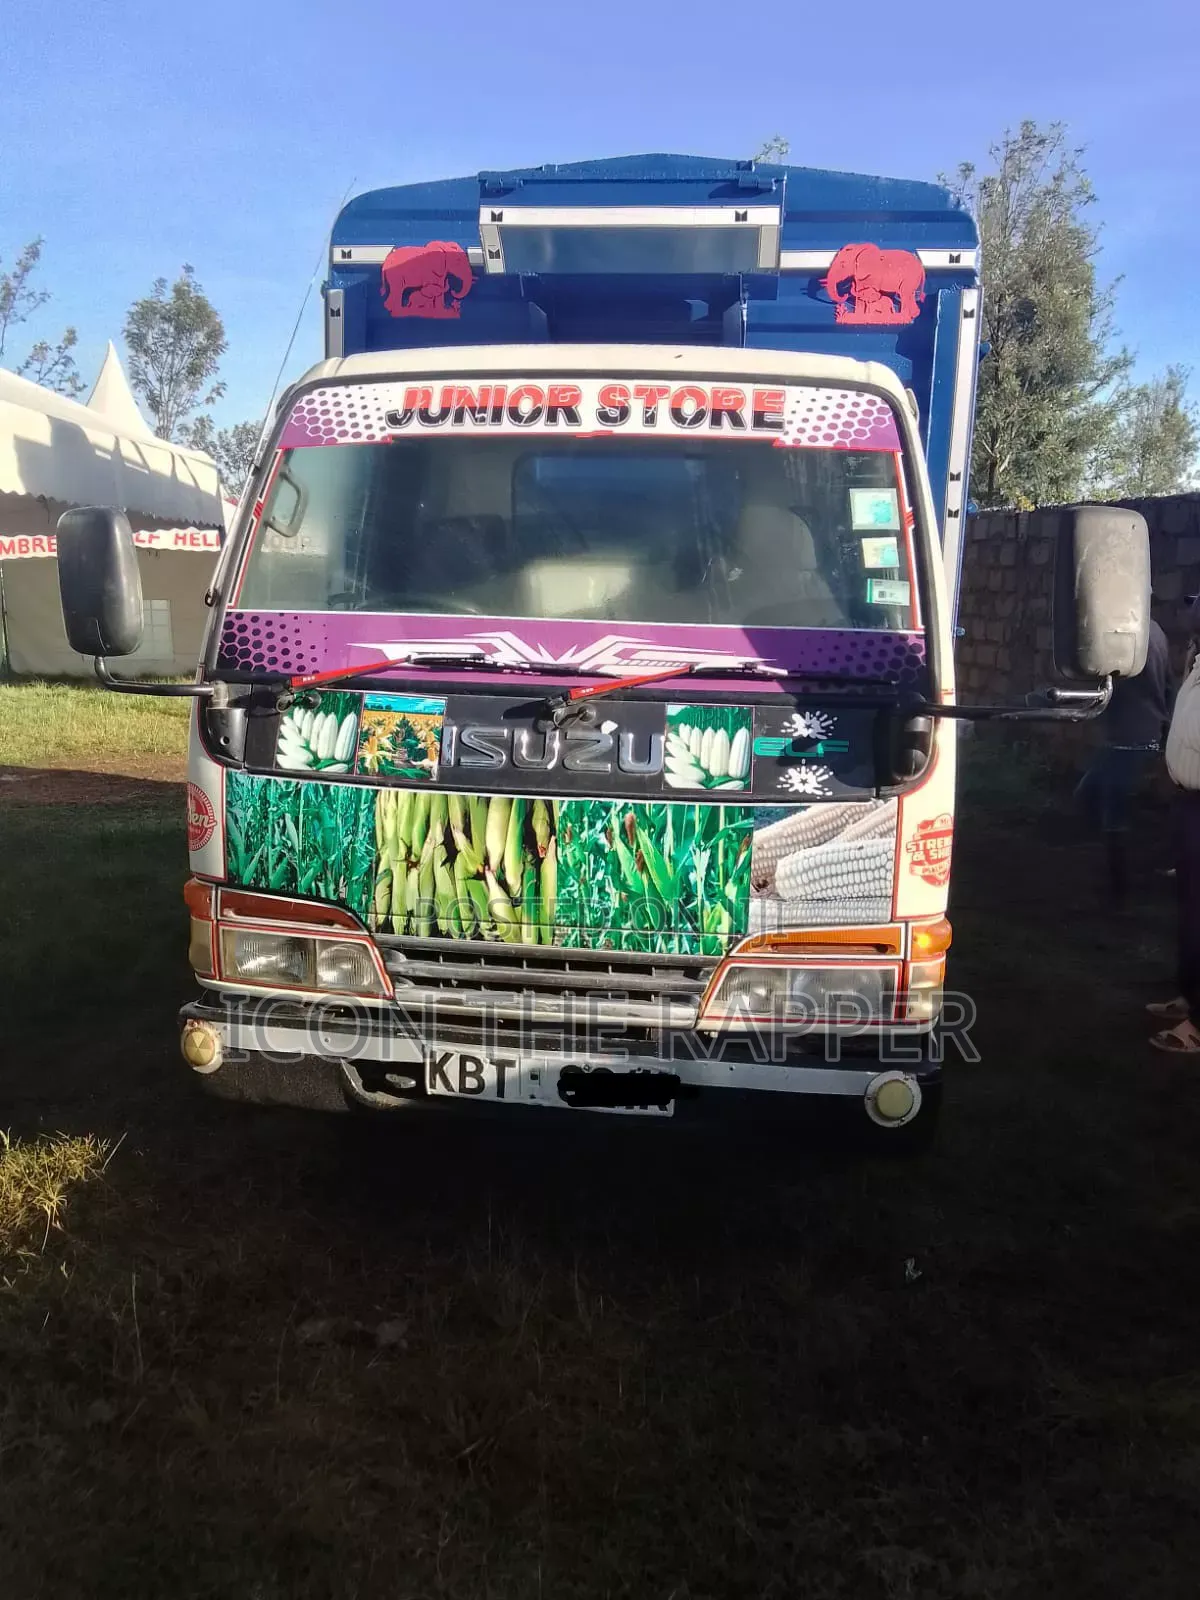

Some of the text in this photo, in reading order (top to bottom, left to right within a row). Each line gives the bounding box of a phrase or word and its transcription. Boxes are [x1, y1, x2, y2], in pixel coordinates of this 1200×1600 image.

[384, 383, 786, 433] JUNIOR STORE
[440, 724, 666, 775] ISUZU
[753, 736, 849, 758] ELF
[429, 1050, 517, 1099] KBT
